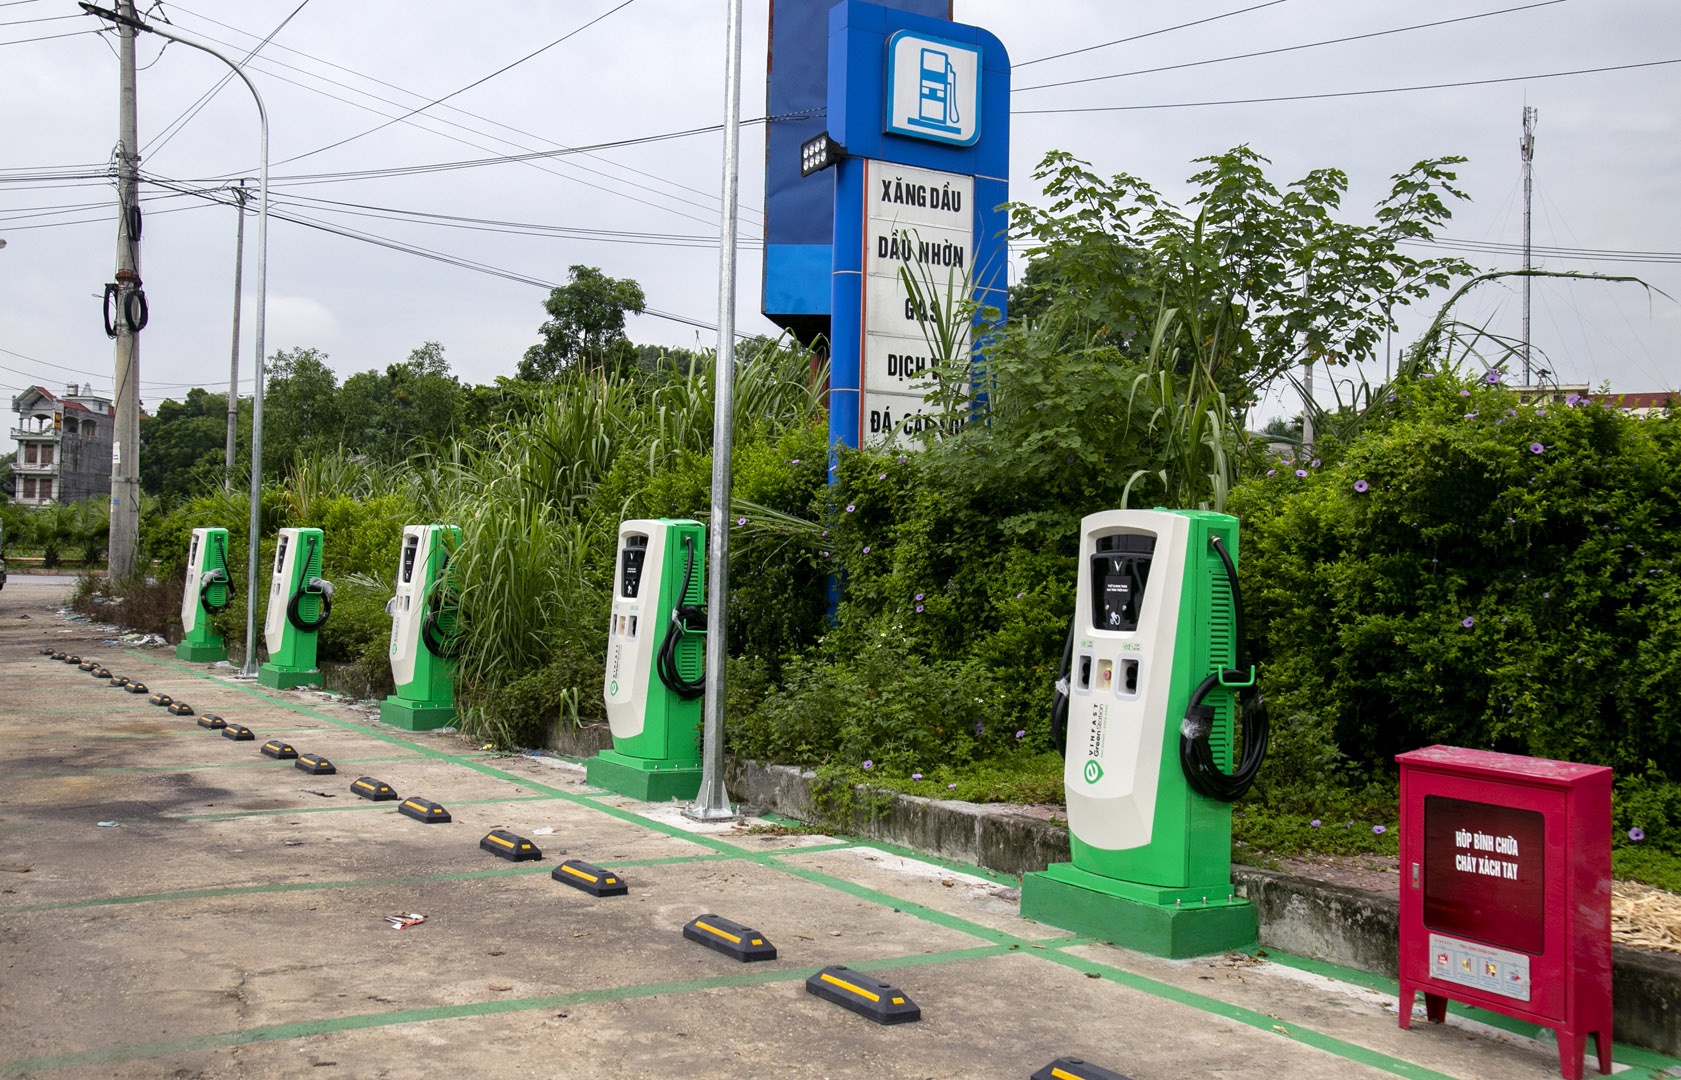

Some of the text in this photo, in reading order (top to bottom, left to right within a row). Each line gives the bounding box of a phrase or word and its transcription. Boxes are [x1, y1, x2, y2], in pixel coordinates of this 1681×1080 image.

[881, 176, 961, 213] XĂNG DẦU
[878, 229, 964, 268] DẦU NHỜN
[887, 353, 926, 381] DỊCH
[870, 405, 892, 434] ĐÁ
[1088, 703, 1098, 756] VINFAST
[1093, 730, 1102, 757] Green
[1473, 830, 1494, 852] BÌNH
[1478, 855, 1501, 878] XÁCH
[1502, 861, 1518, 881] TAY
